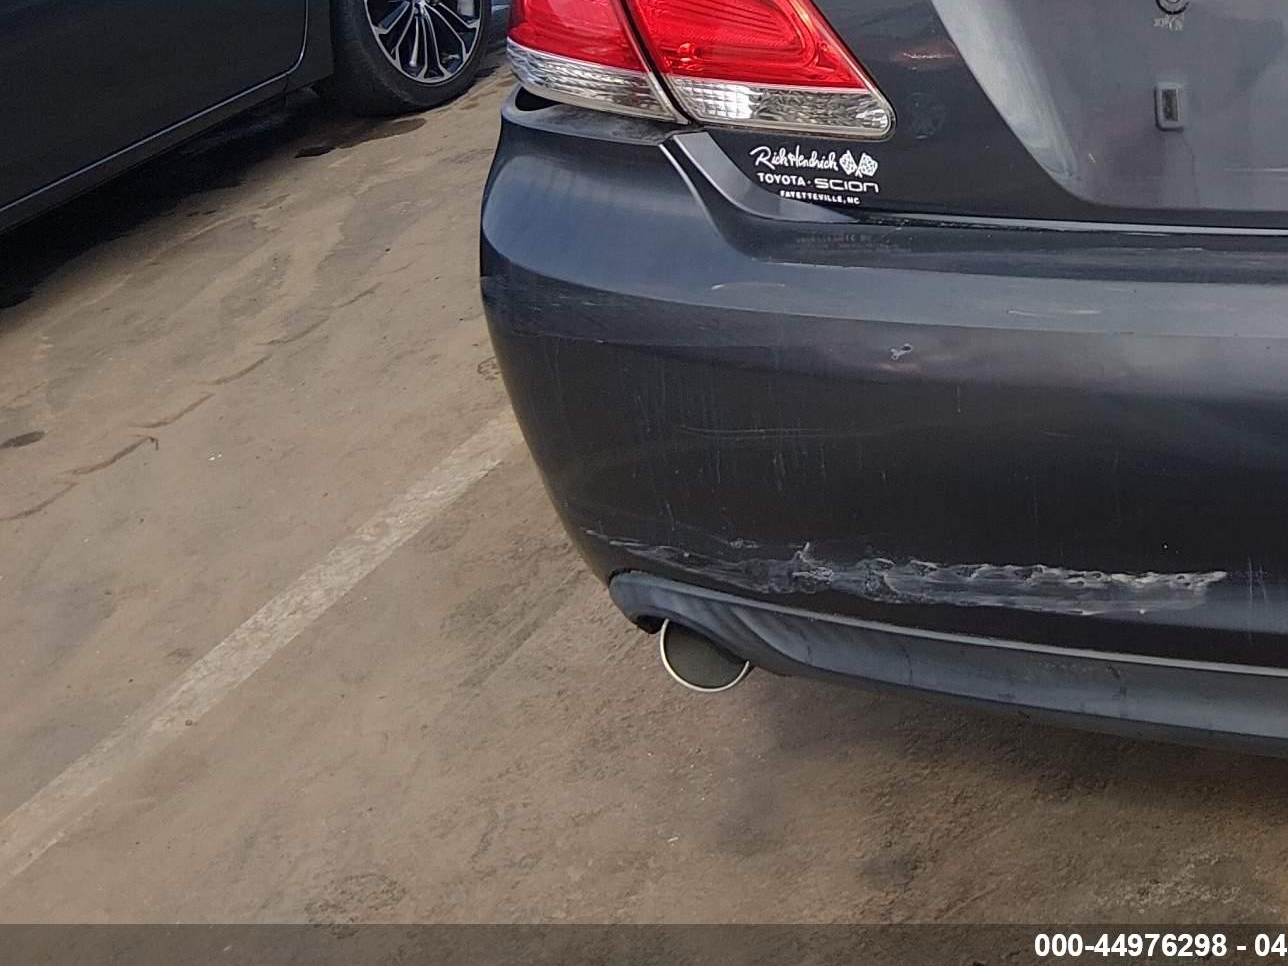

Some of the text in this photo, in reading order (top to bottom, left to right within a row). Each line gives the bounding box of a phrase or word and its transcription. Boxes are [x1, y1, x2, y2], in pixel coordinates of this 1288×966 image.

[756, 173, 879, 193] TOYOTA SCION
[846, 196, 861, 205] NC
